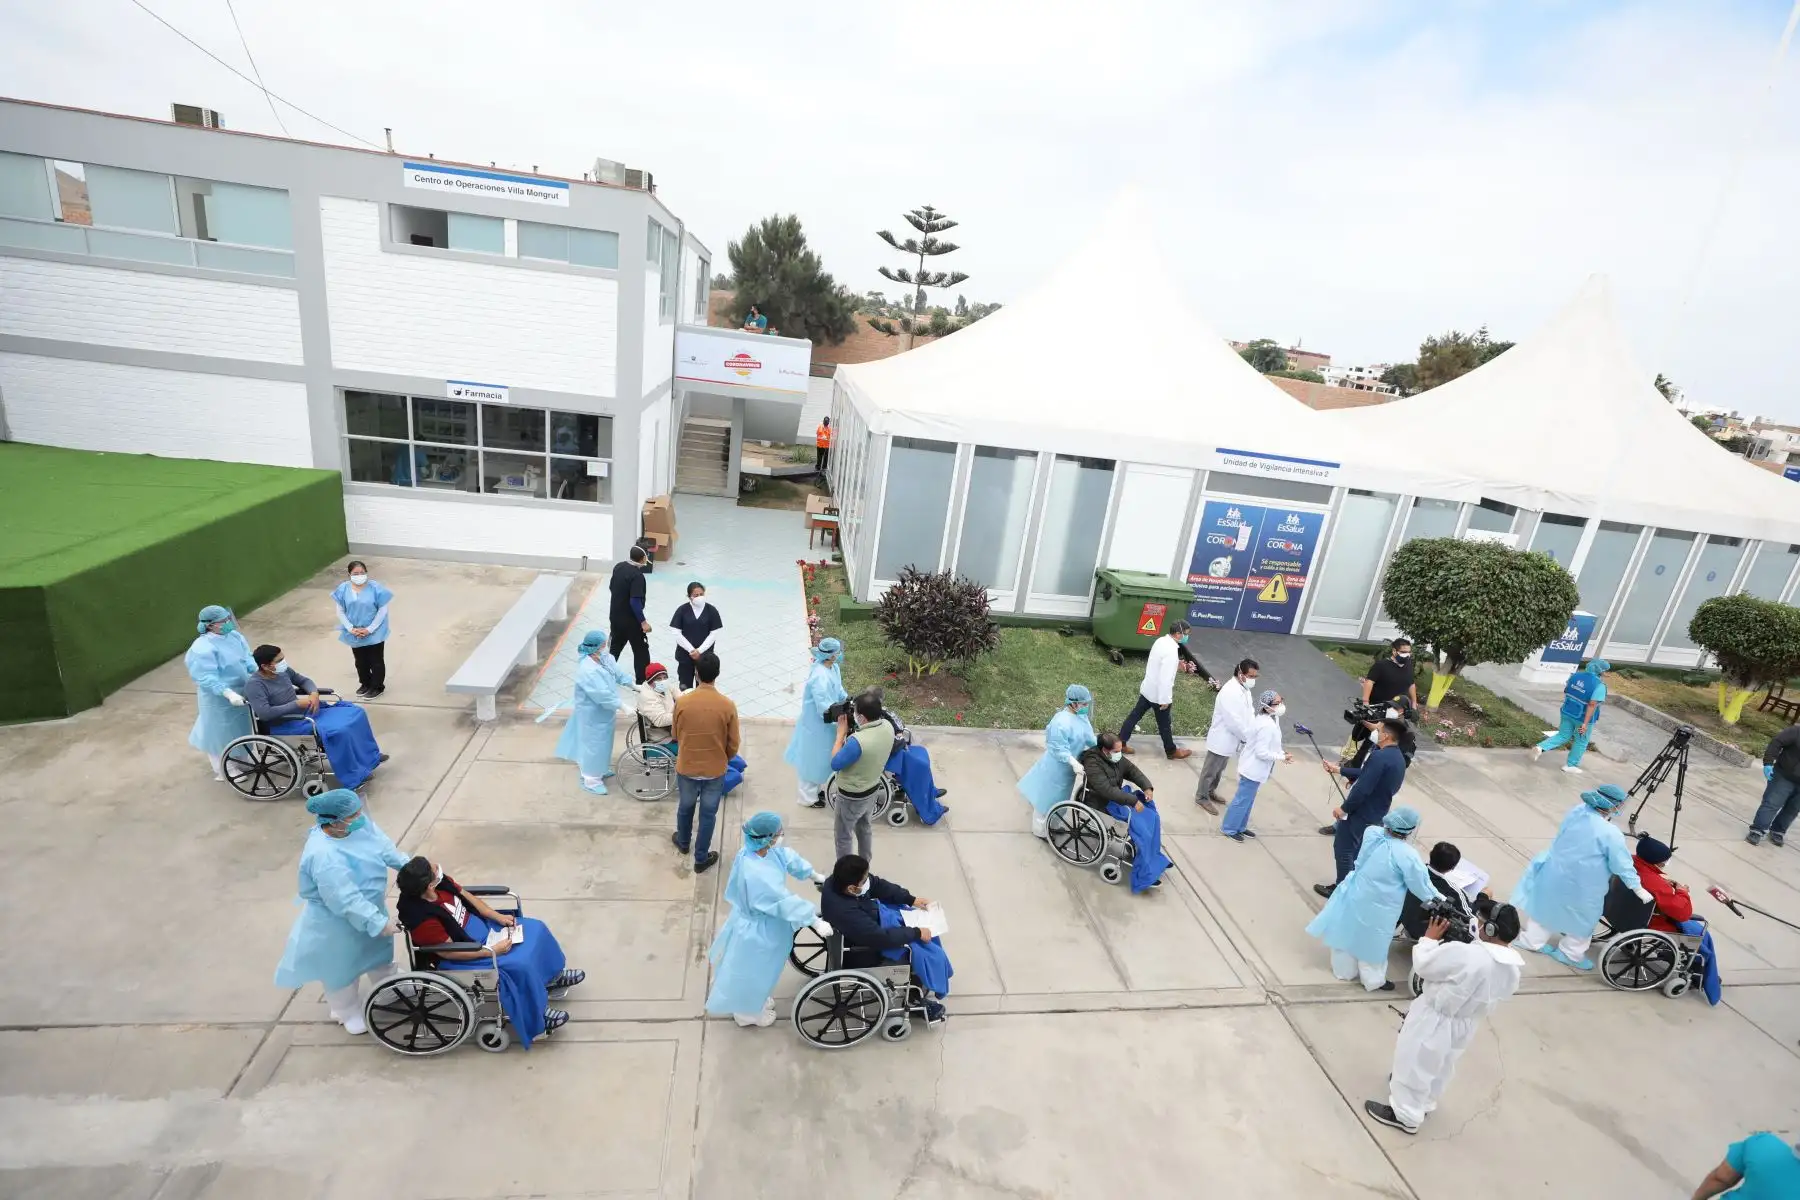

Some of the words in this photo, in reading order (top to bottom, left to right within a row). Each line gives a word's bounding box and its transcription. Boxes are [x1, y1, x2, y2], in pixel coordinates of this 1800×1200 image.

[414, 174, 442, 185] Centro
[443, 178, 454, 186] de
[455, 179, 506, 193] Operaciones
[507, 186, 525, 195] Villa
[526, 188, 559, 200] Mongrut
[465, 389, 502, 399] Farmacia
[1223, 457, 1248, 466] Unidad
[1249, 460, 1258, 468] de
[1259, 462, 1292, 473] Vigilancia
[1292, 466, 1323, 477] Intensiva
[1216, 517, 1247, 528] EsSalud
[1277, 523, 1305, 534] EsSalud
[1549, 640, 1583, 652] EsSalud
